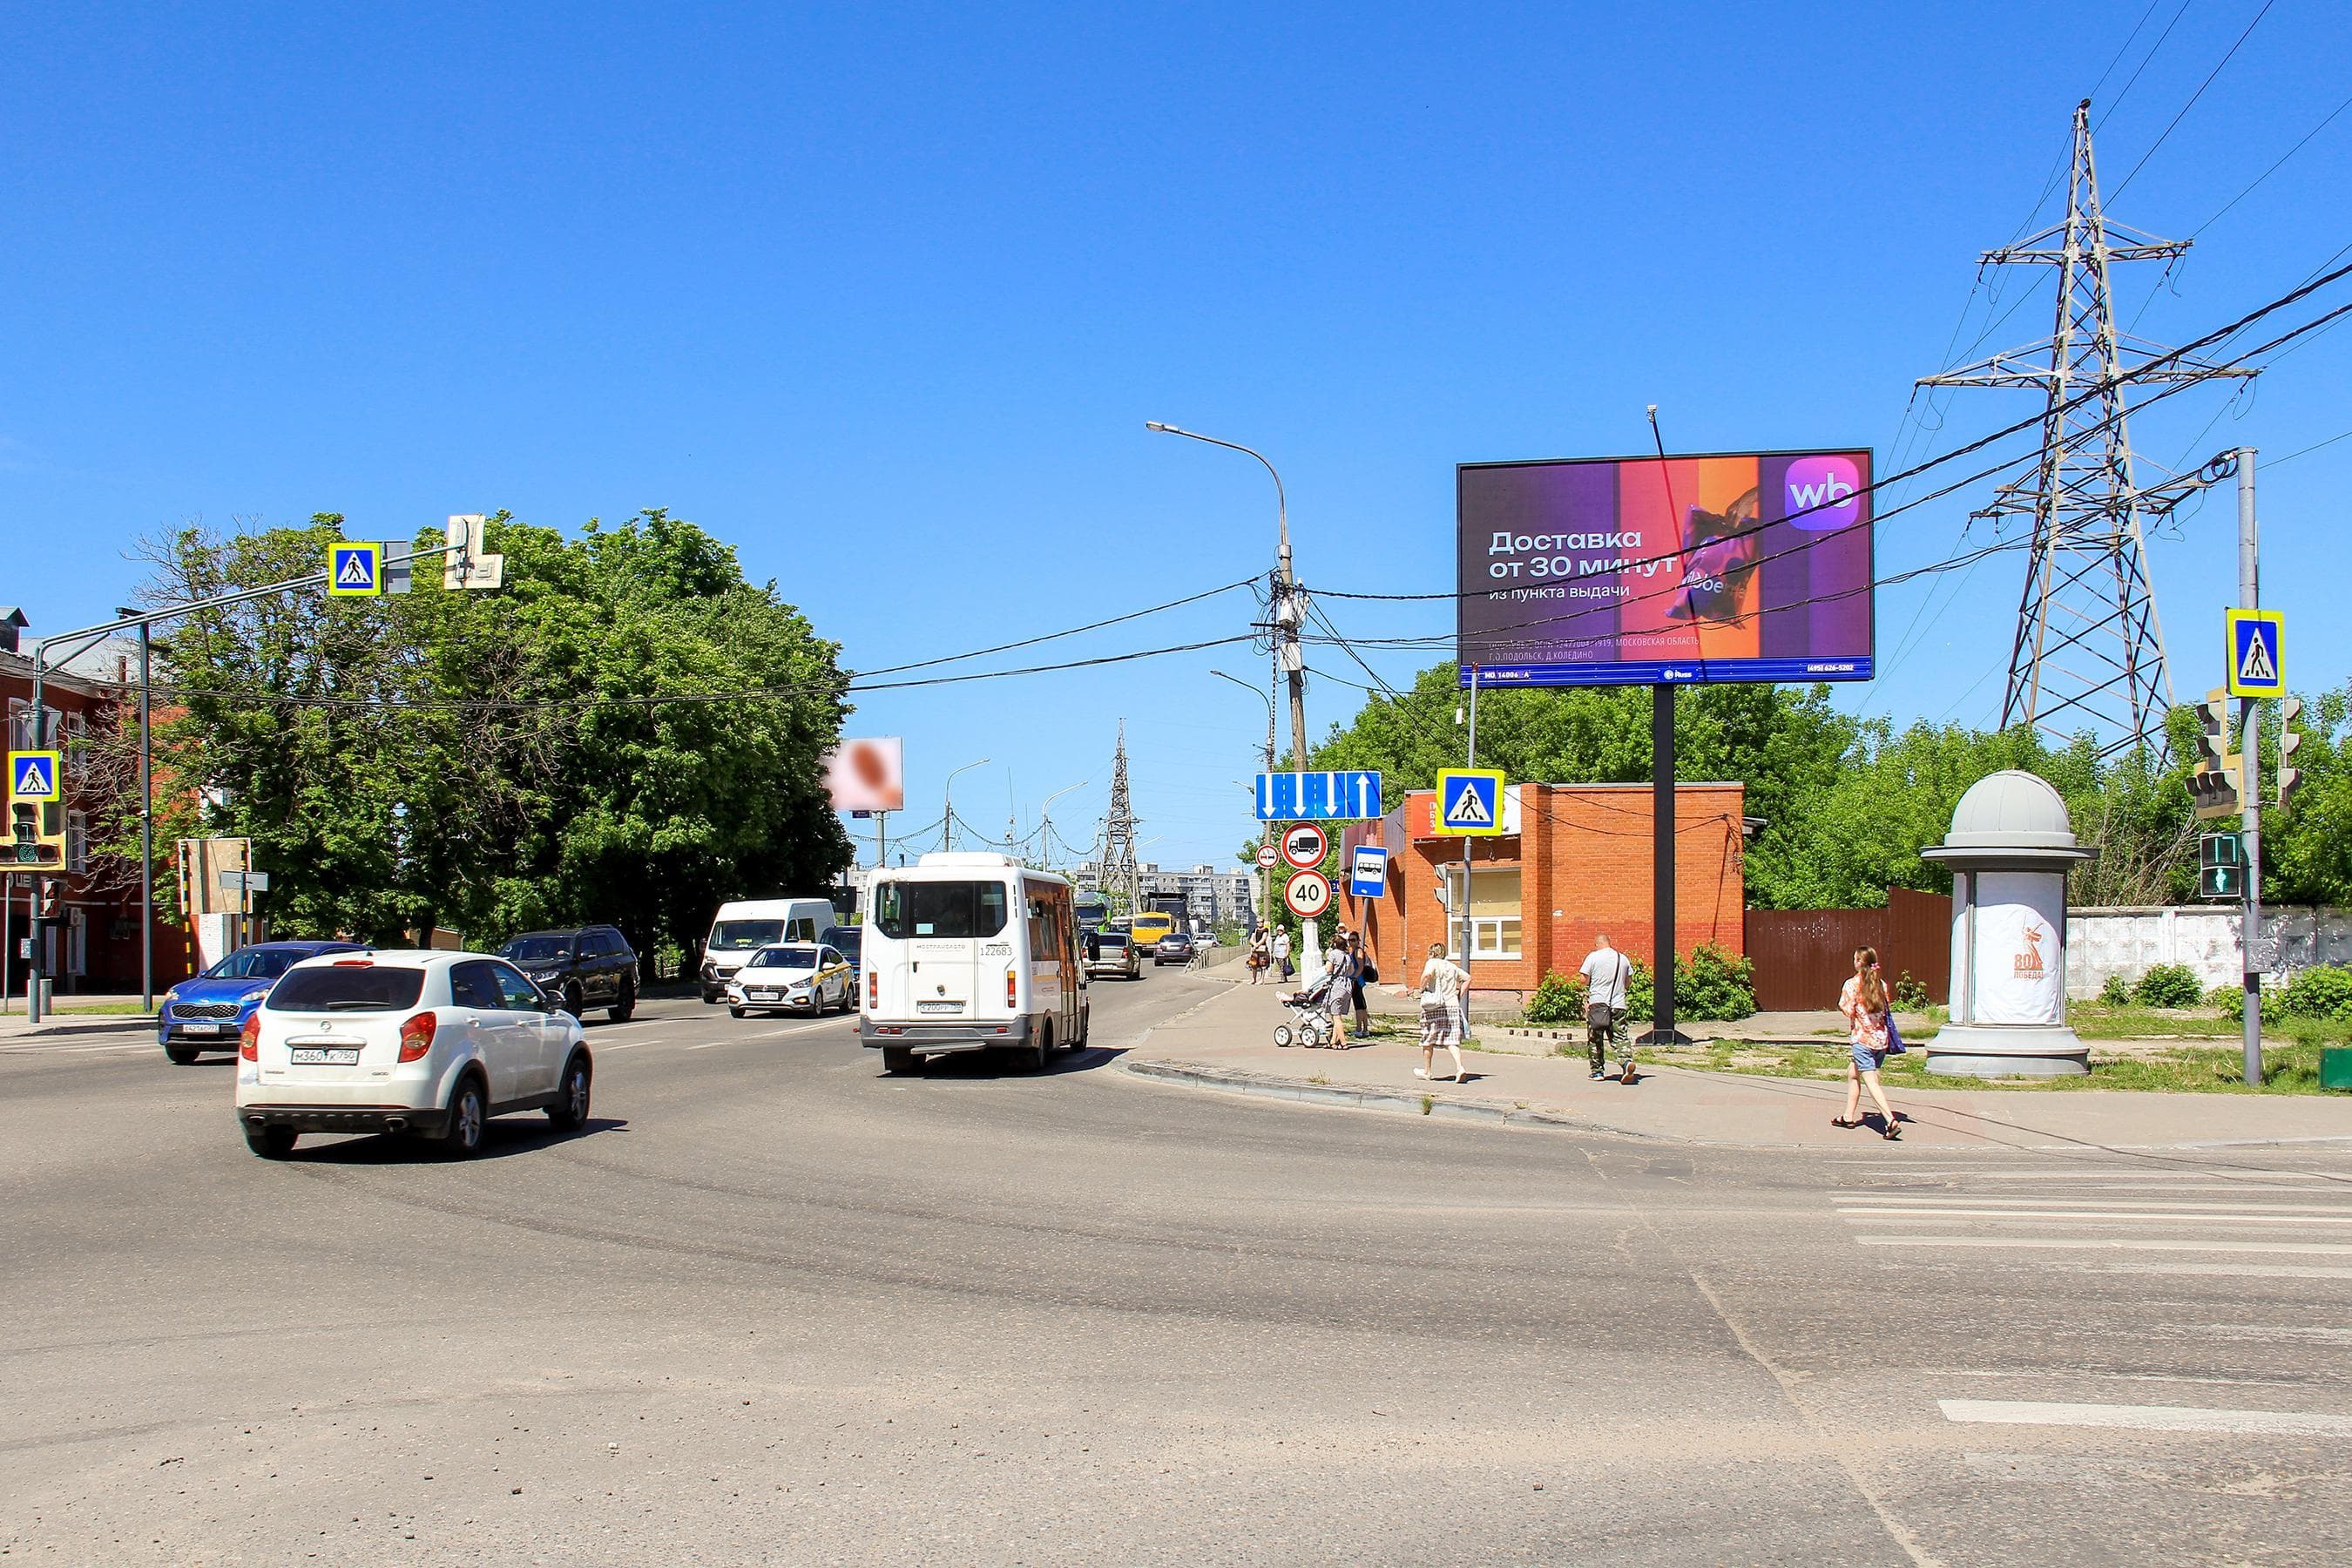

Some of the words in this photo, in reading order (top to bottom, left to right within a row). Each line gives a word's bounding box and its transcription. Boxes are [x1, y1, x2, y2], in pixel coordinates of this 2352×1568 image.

[1789, 472, 1854, 508] wb
[1489, 531, 1641, 555] Доставка
[1489, 562, 1524, 578] от
[1530, 556, 1571, 578] 30
[1579, 557, 1678, 577] минут
[1490, 590, 1507, 600] из
[1511, 587, 1565, 602] пункта
[1569, 585, 1630, 600] выдачи
[1616, 637, 1665, 647] МОСКОВСКАЯ
[2214, 836, 2236, 862] 17
[1295, 884, 1320, 902] 40
[980, 946, 1012, 956] 122683
[2014, 953, 2031, 969] 80
